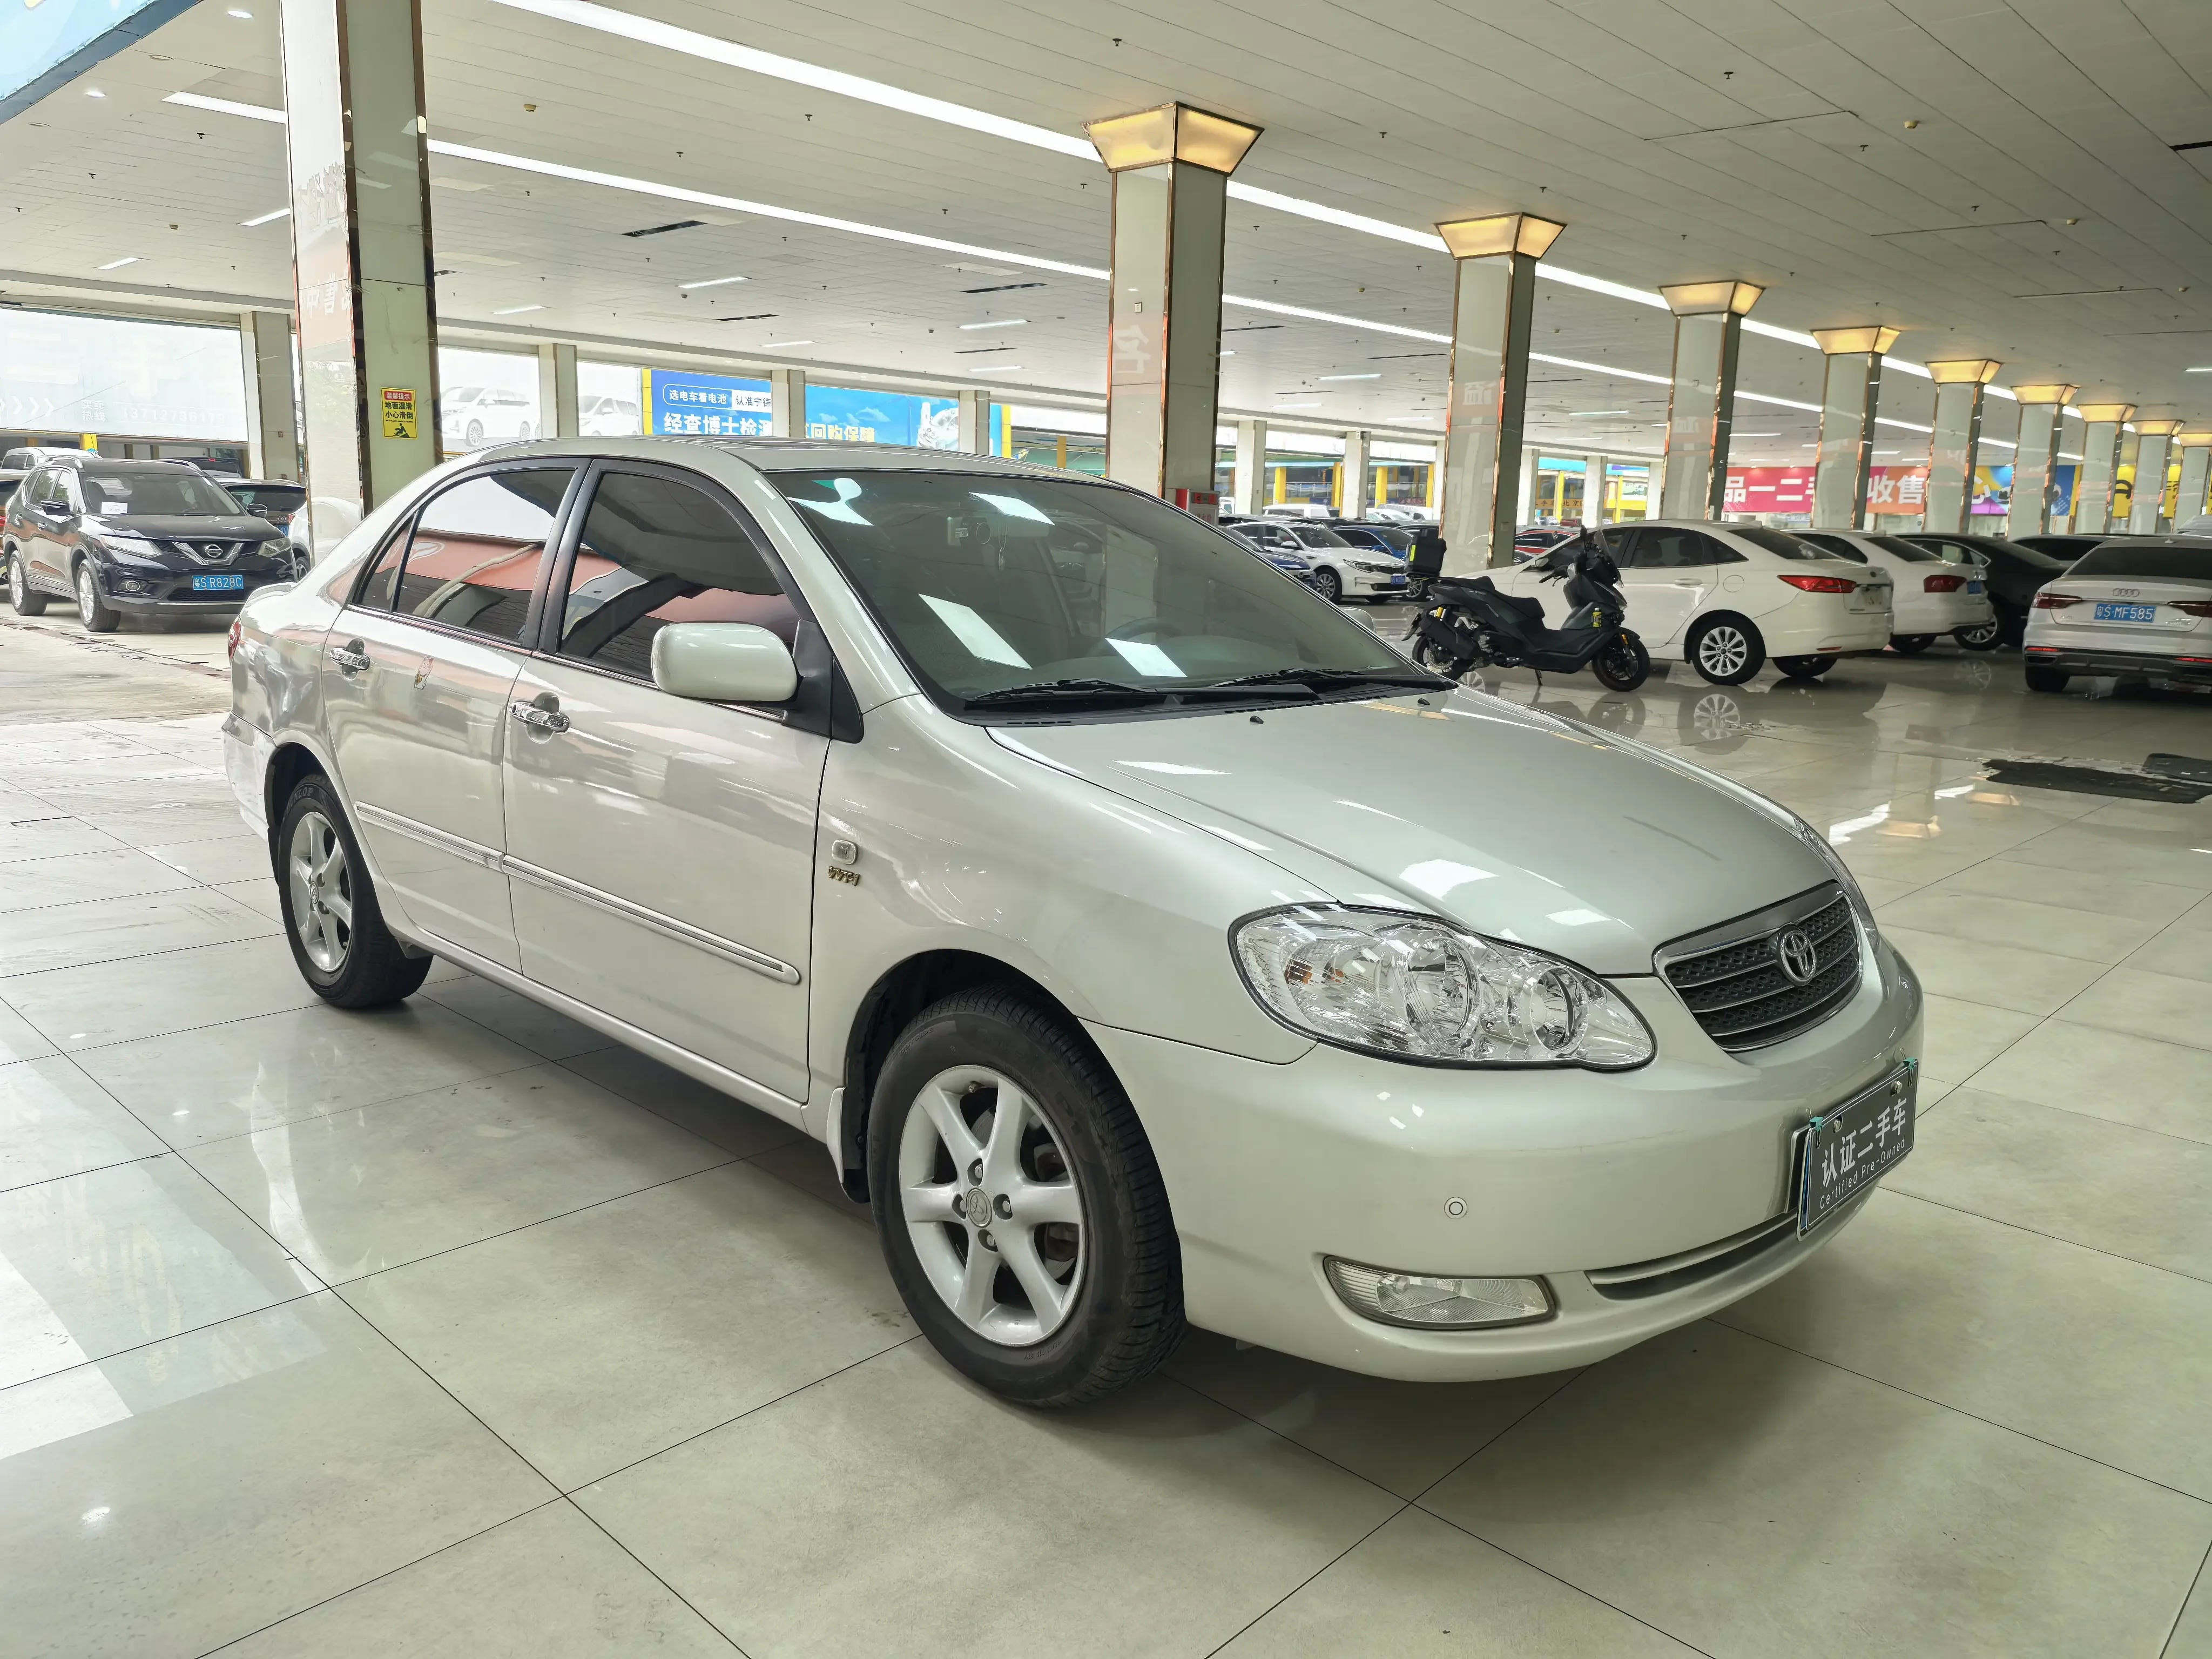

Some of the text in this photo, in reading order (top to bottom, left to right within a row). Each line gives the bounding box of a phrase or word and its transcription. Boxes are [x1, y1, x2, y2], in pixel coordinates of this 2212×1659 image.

[669, 389, 727, 404] 选电车看电池
[736, 395, 771, 408] 认准宁德
[82, 400, 105, 410] 买卖
[385, 402, 413, 410] 地面湿滑
[82, 410, 106, 421] 热线
[386, 410, 414, 419] 小心滑倒
[1867, 475, 1925, 504] 收售
[1822, 1097, 1907, 1188] 认证二手车
[1820, 1136, 1905, 1210] Certified Pre-Owned
